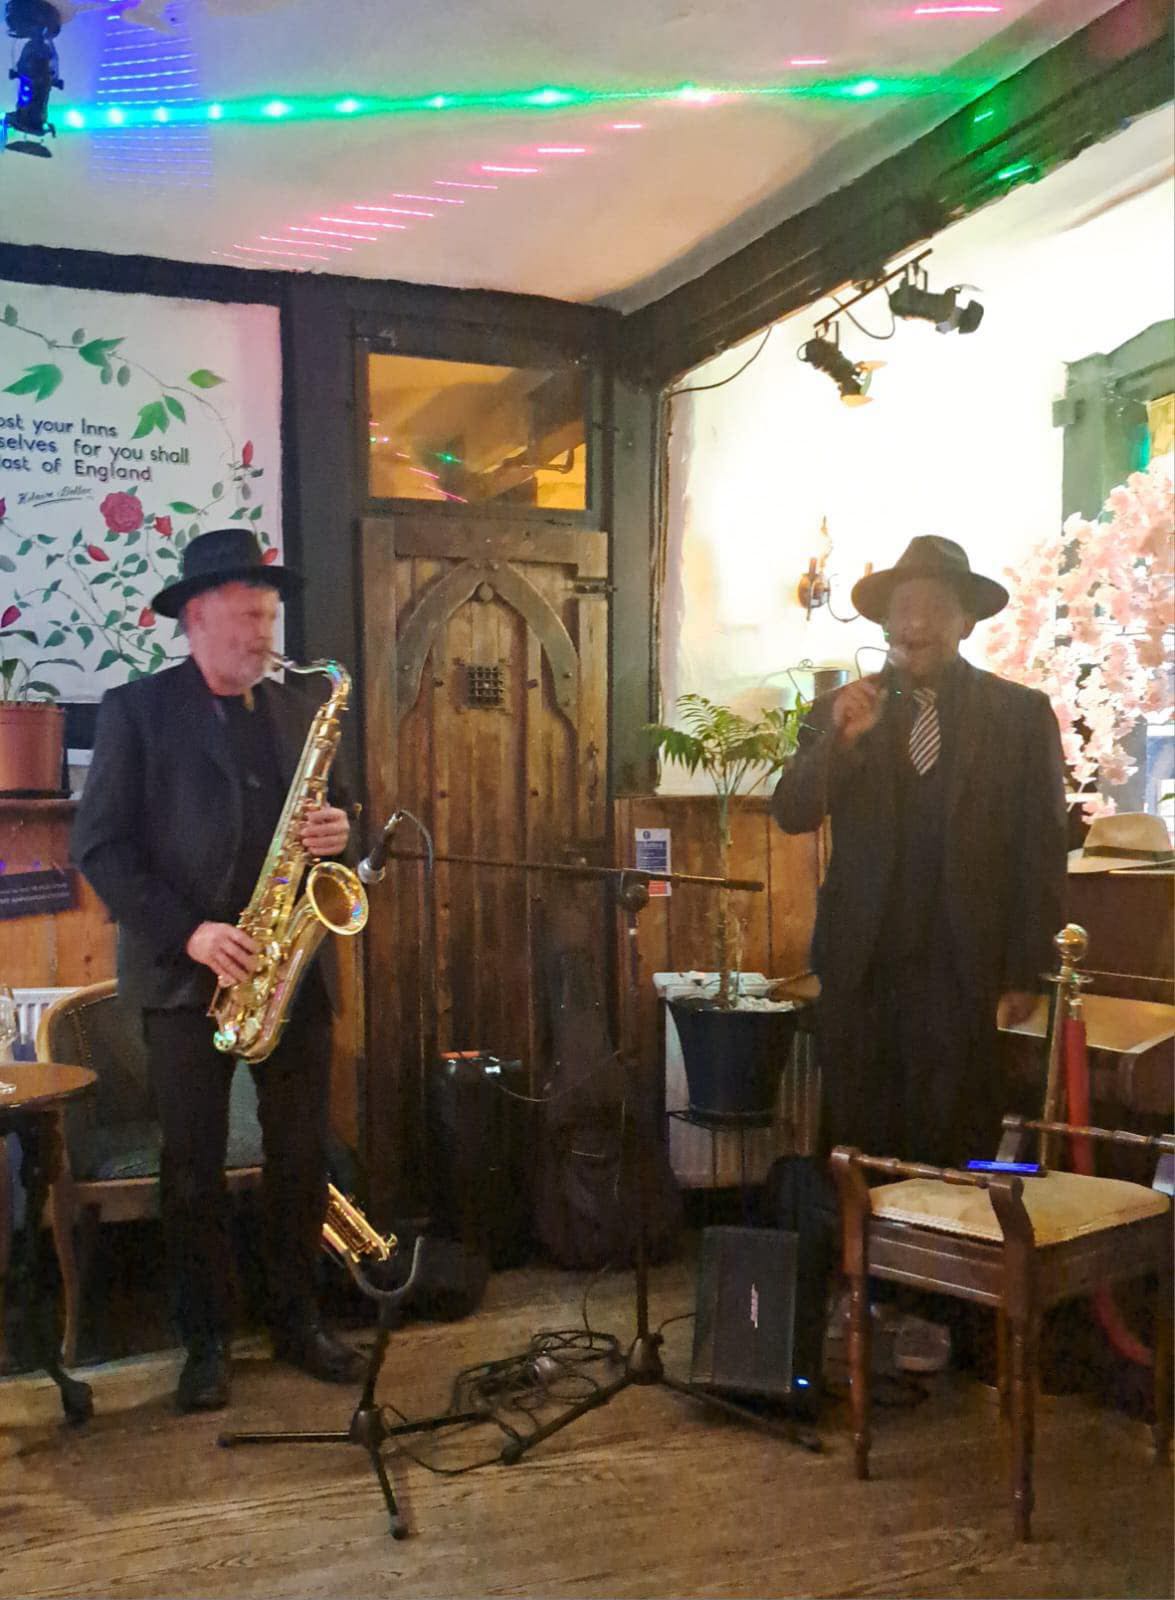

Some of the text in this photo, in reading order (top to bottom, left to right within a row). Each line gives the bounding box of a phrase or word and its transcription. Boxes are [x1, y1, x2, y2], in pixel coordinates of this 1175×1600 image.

[32, 419, 73, 435] your
[81, 418, 117, 437] Inns
[74, 438, 101, 456] for
[108, 446, 143, 464] you
[150, 445, 189, 464] shall
[42, 457, 62, 473] of
[74, 459, 152, 482] England
